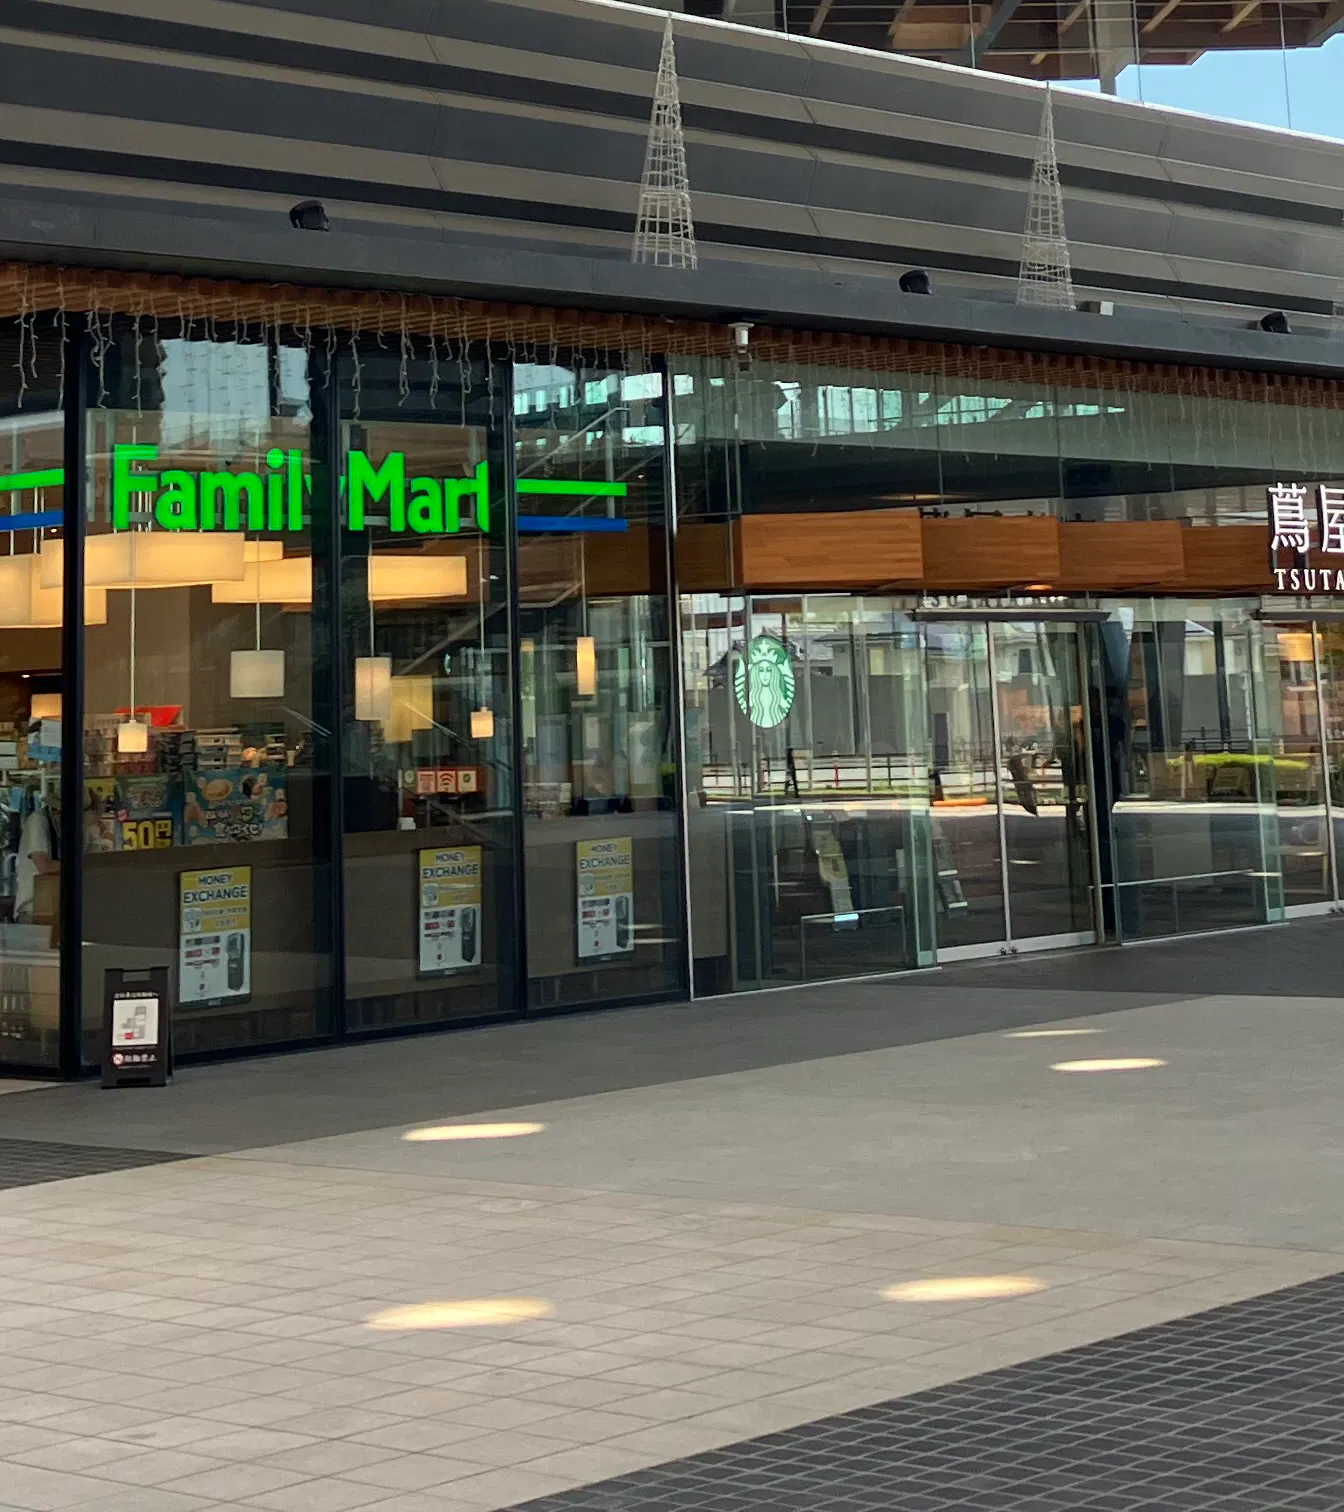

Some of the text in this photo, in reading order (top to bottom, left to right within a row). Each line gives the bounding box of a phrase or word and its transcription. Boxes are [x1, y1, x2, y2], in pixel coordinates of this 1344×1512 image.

[579, 854, 631, 869] EXCHANGE
[422, 863, 478, 879] EXCHANGE
[198, 873, 233, 886] MONEY
[183, 885, 248, 904] EXCHANGE
